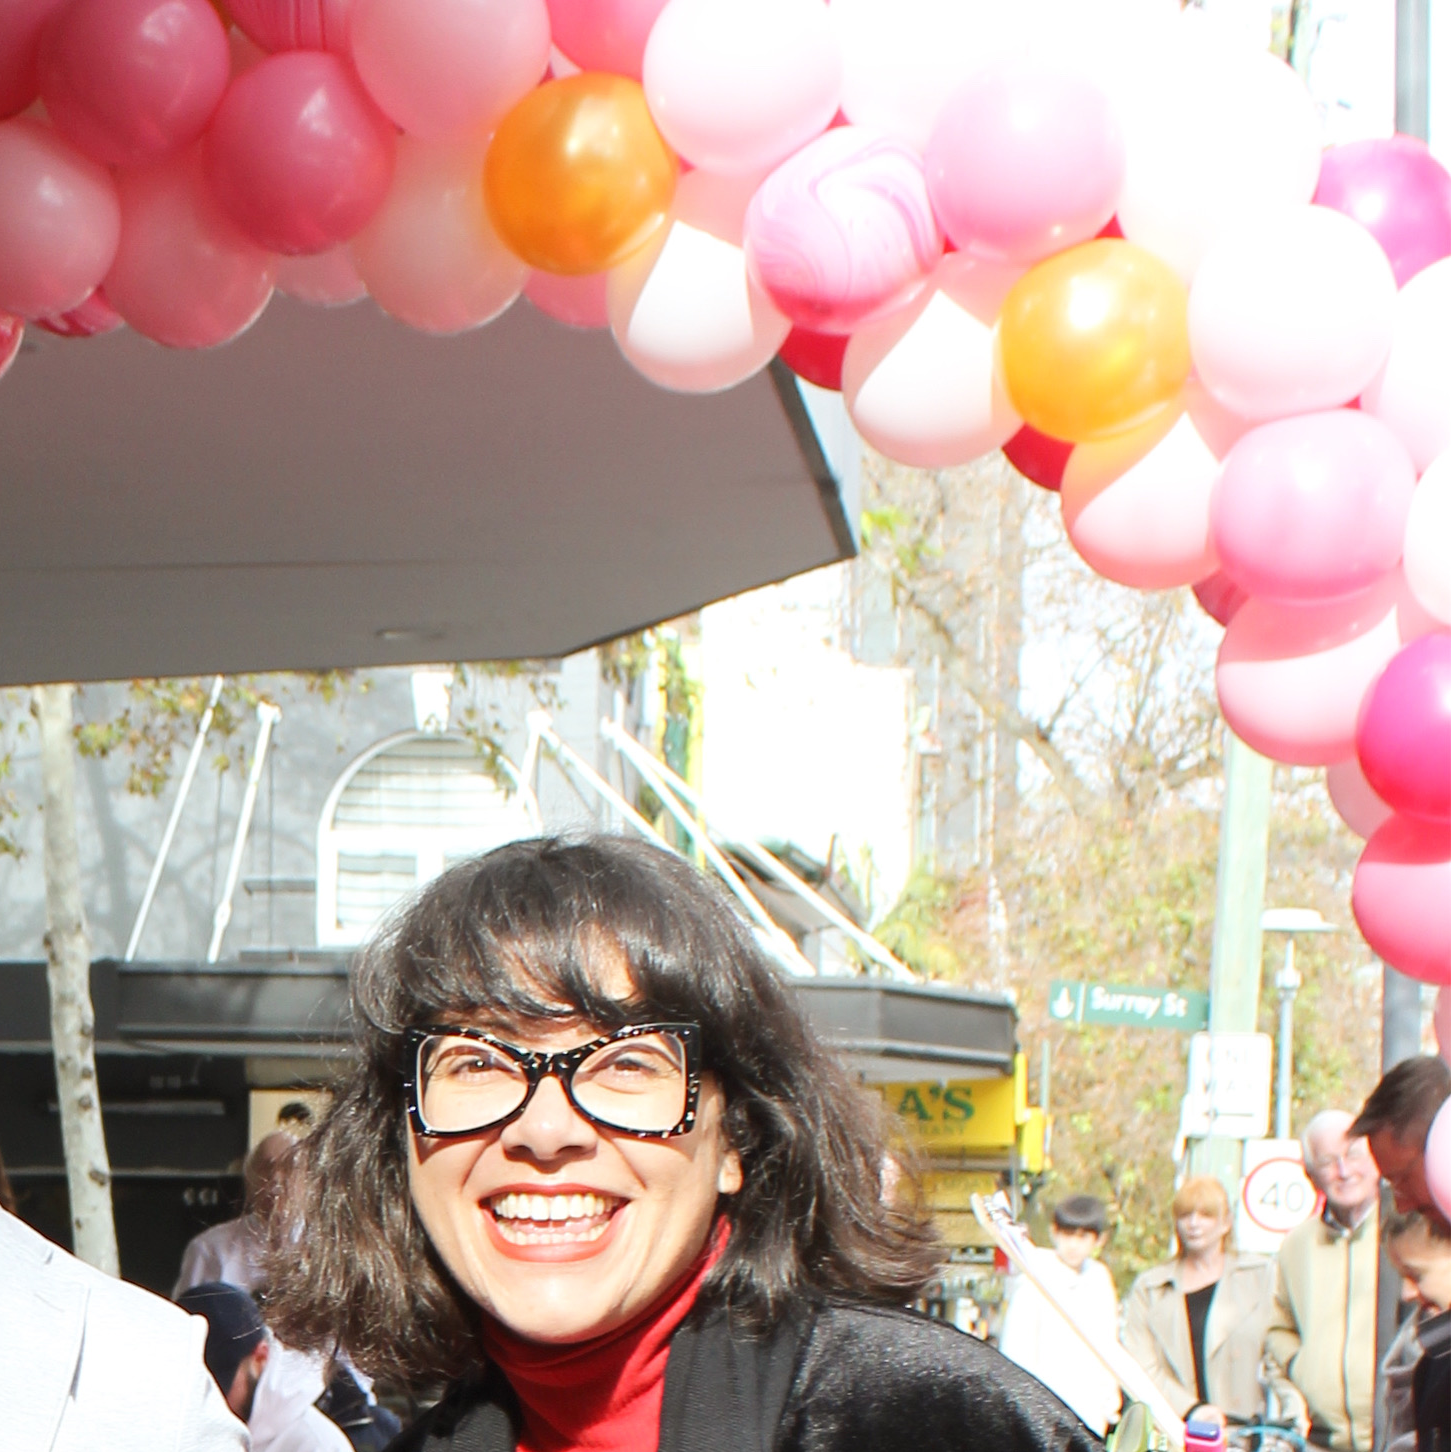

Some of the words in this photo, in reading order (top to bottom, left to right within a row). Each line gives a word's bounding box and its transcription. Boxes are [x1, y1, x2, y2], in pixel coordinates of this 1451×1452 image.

[1091, 985, 1161, 1020] Surrey
[1163, 992, 1187, 1018] St
[1259, 1181, 1306, 1213] 40
